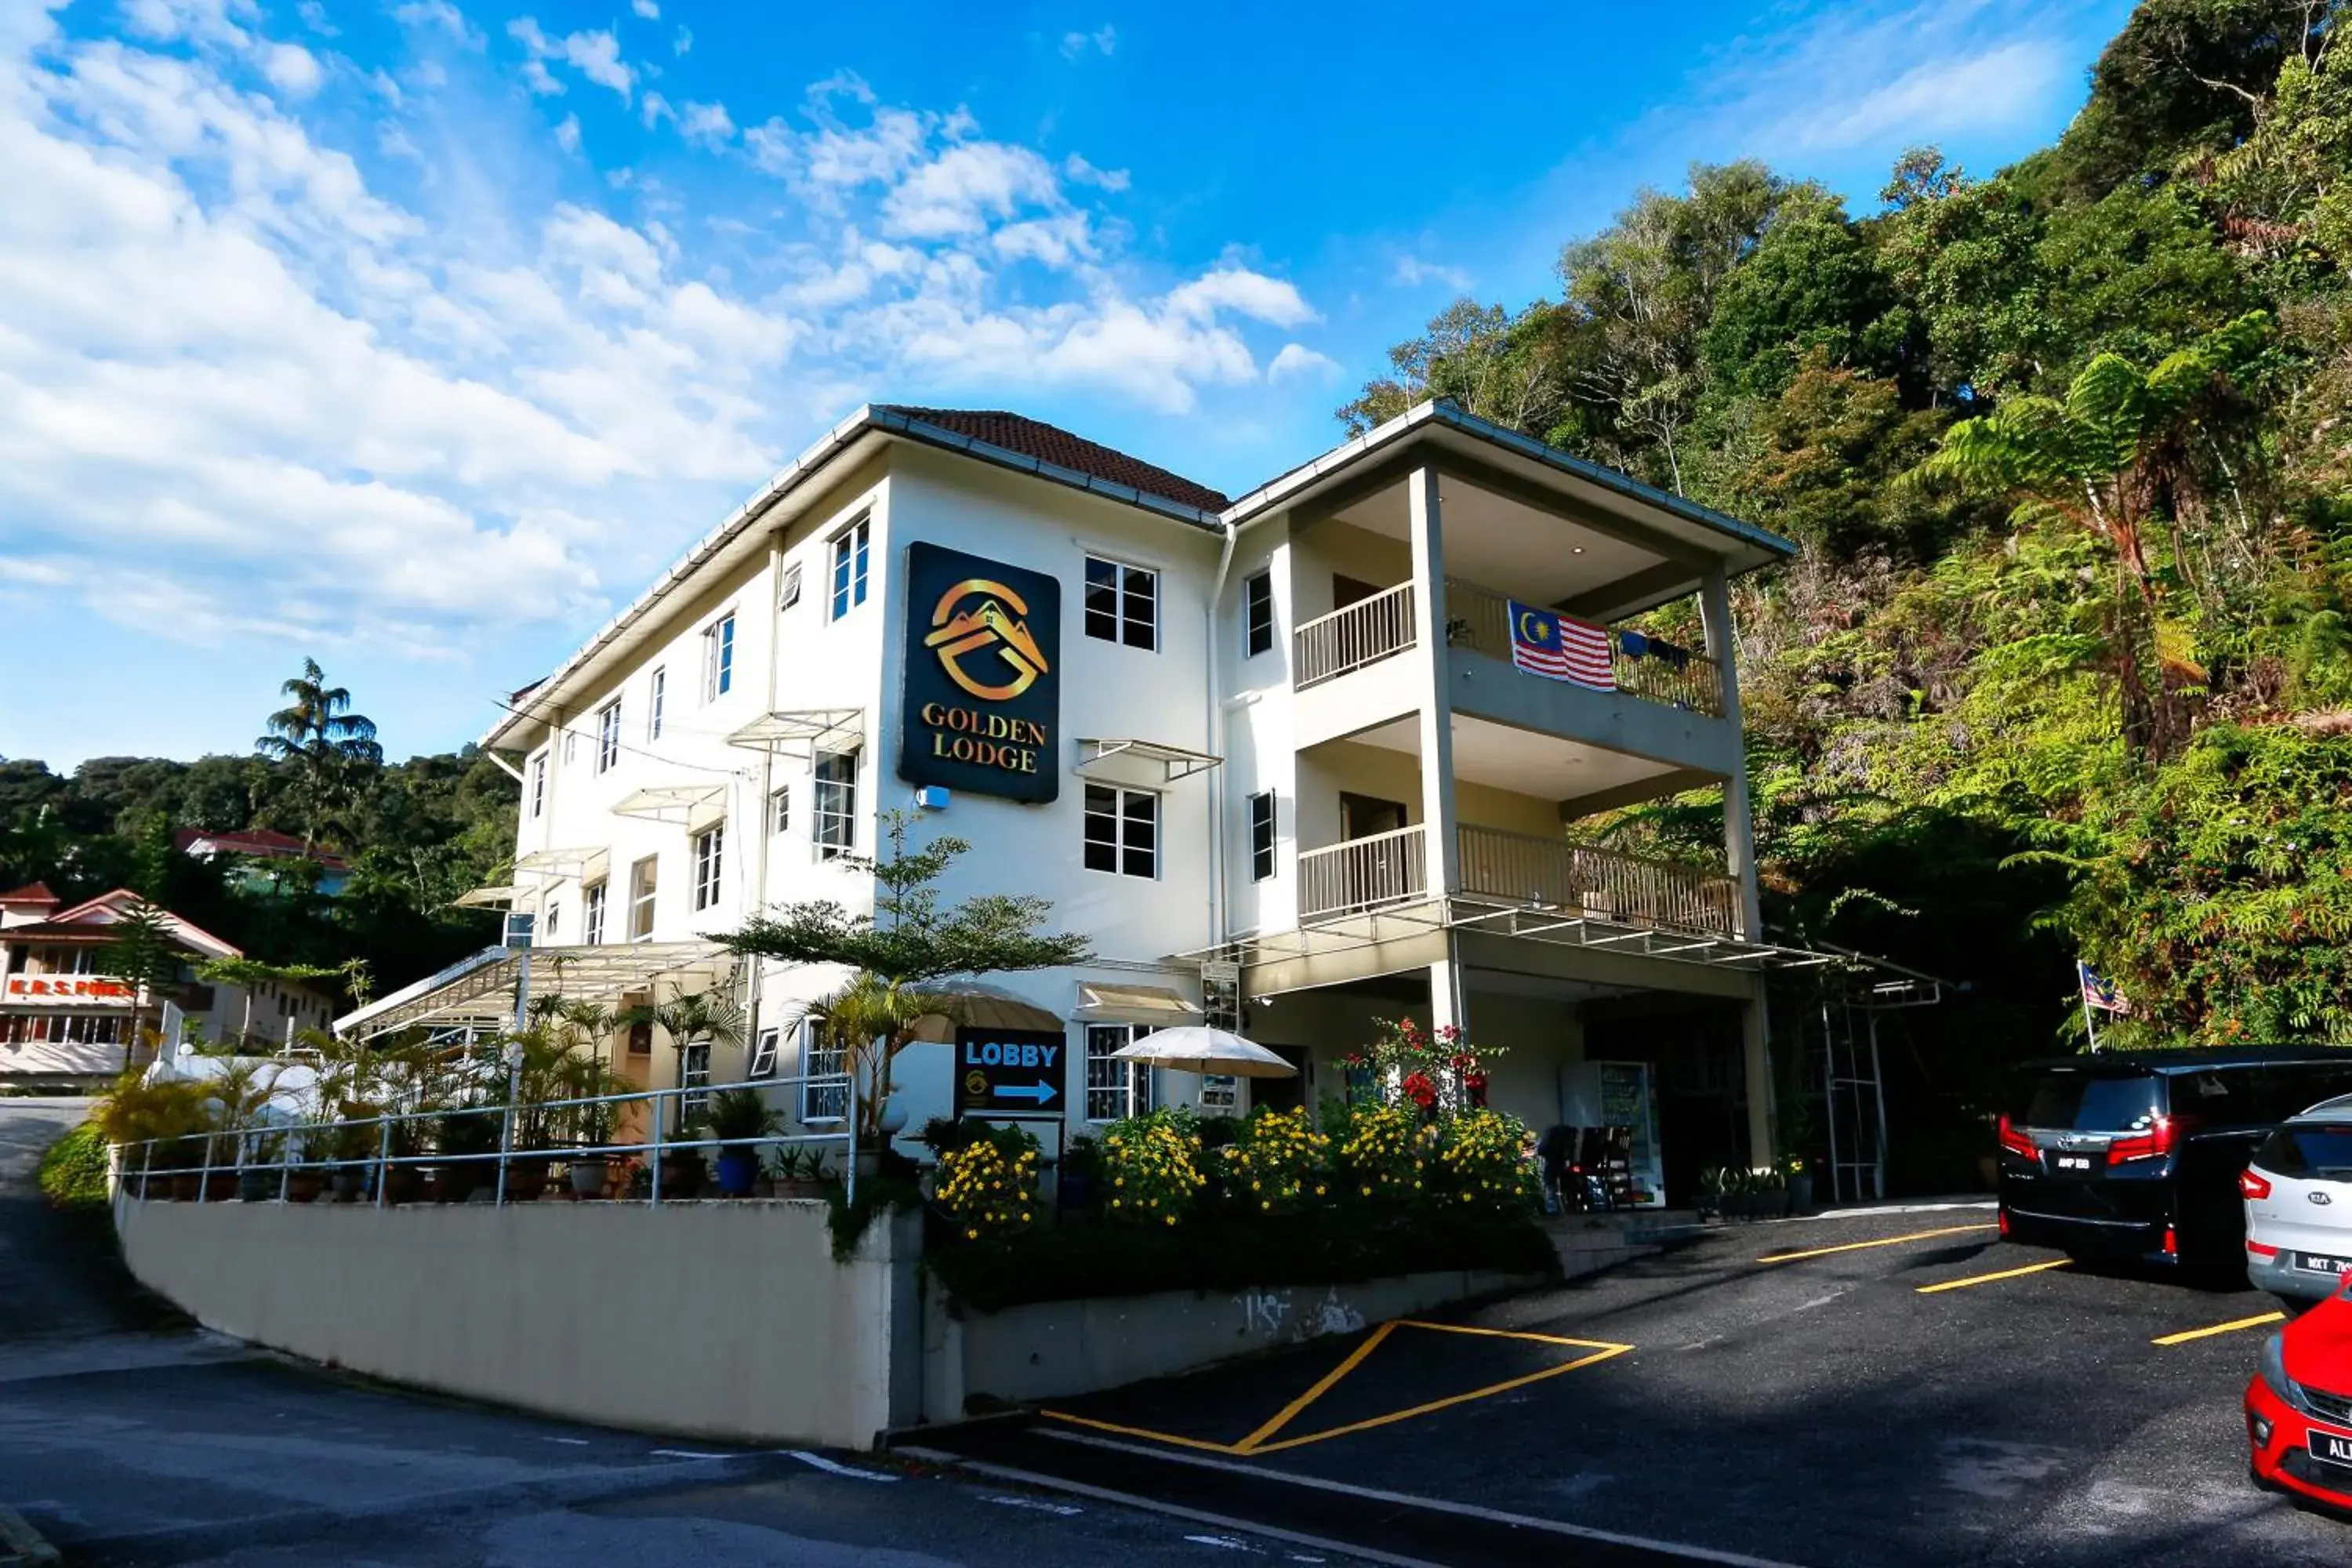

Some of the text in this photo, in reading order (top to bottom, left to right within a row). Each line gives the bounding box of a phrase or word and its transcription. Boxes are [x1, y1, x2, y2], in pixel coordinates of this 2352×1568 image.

[923, 703, 1047, 746] GOLDEN
[933, 733, 1036, 773] LODGE
[966, 1041, 1058, 1067] LOBBY
[2310, 1193, 2329, 1203] KIA
